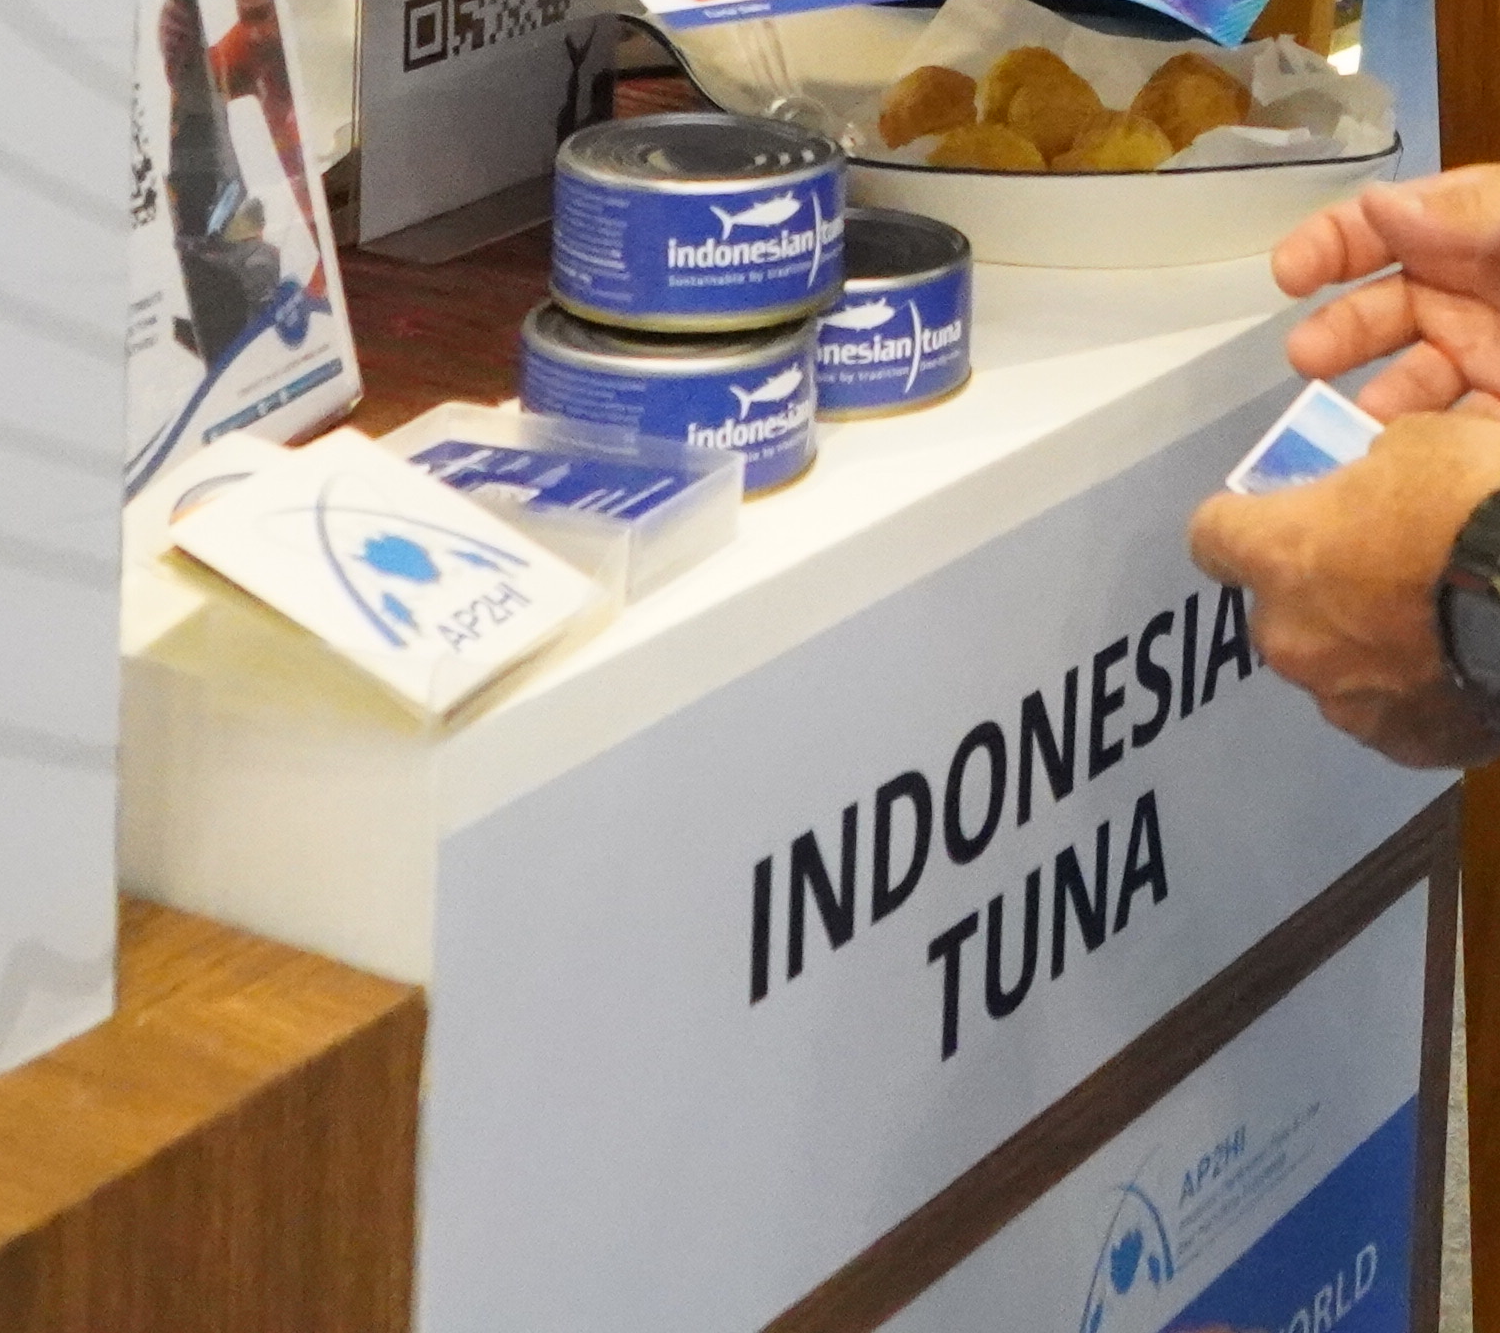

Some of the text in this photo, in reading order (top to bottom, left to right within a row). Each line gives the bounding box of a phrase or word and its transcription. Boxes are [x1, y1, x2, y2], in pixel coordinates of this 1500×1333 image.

[668, 230, 813, 268] indonesian
[922, 321, 962, 353] tuna
[436, 581, 532, 654] AP2HI
[750, 583, 1270, 1007] INDONESIA
[927, 789, 1169, 1062] TUNA
[1179, 1124, 1246, 1208] AP2HI
[1278, 1242, 1379, 1333] ORLD
